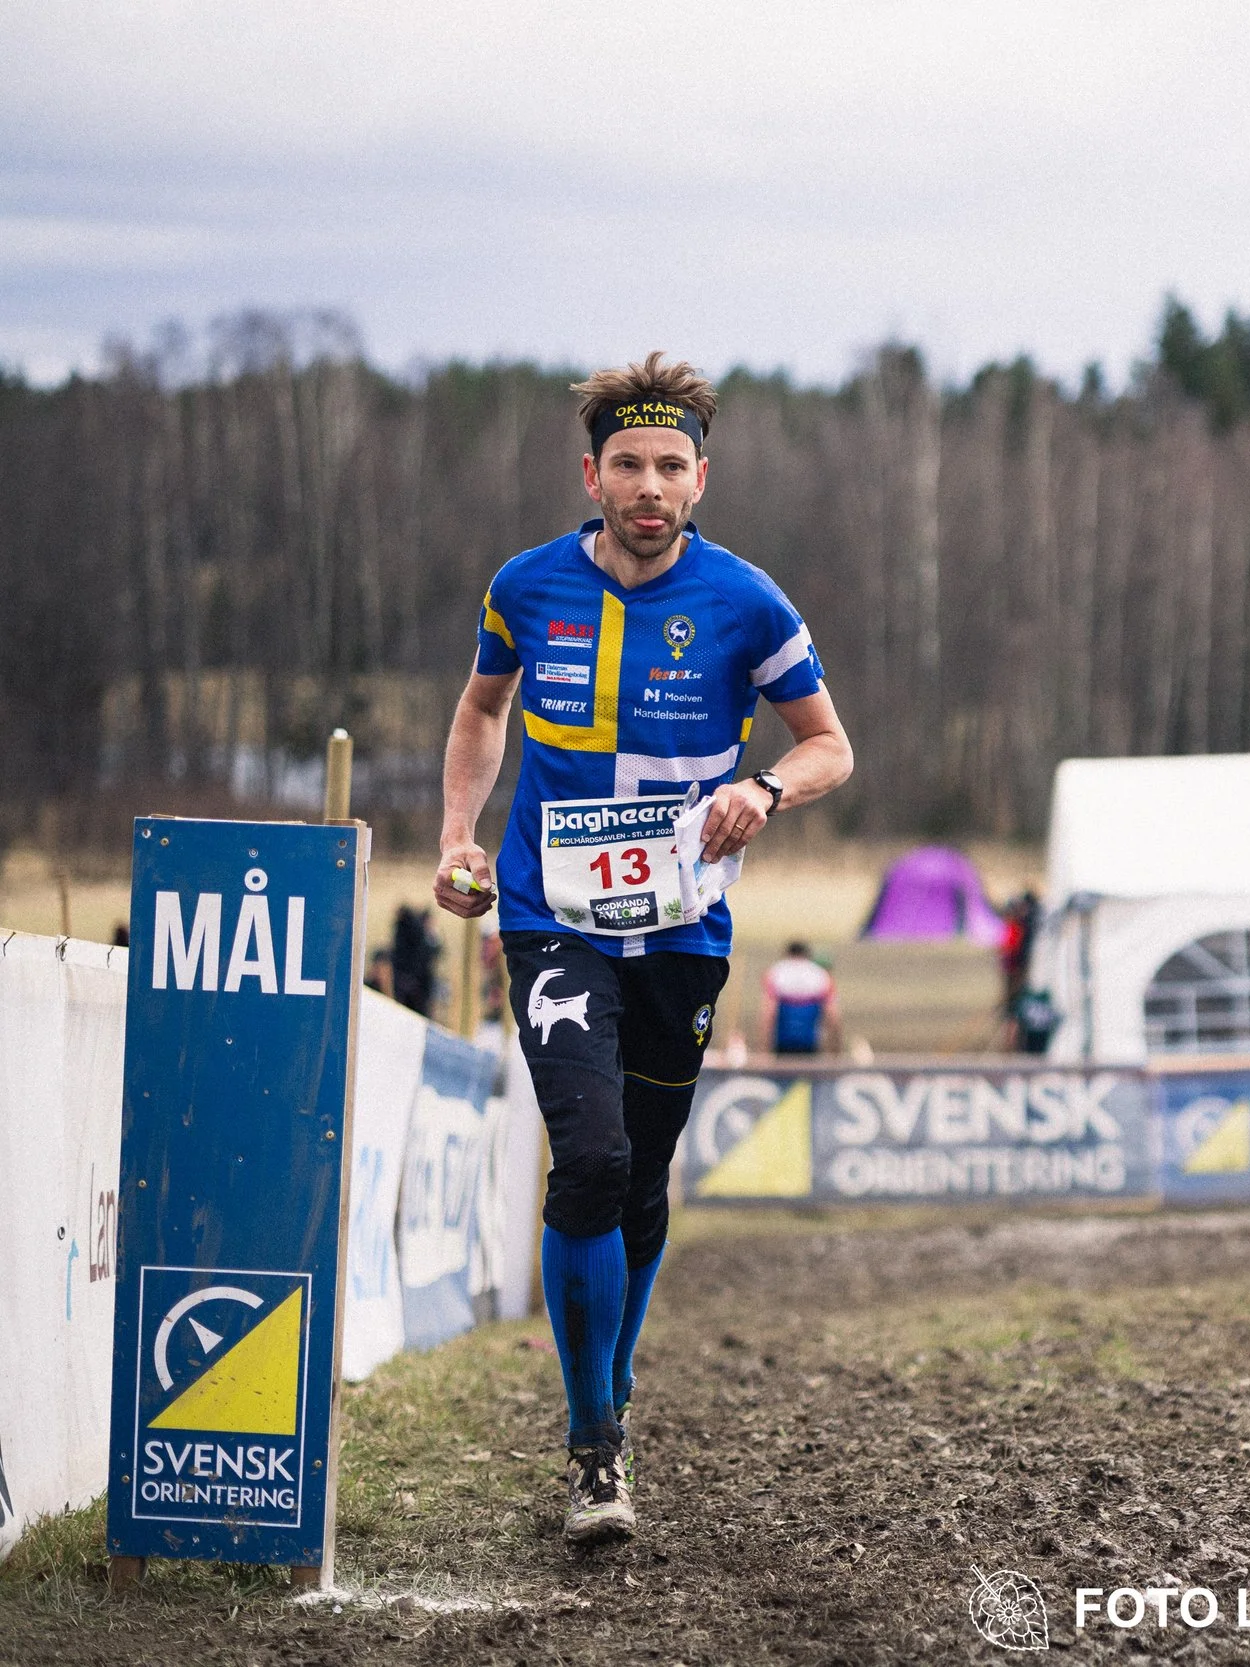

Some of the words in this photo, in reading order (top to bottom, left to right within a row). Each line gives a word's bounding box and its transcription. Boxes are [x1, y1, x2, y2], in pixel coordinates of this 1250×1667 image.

[616, 404, 638, 417] OK
[642, 401, 686, 419] KÅRE
[623, 415, 678, 427] FALUN
[541, 697, 588, 713] TRIMTEX
[664, 692, 703, 703] Moelven
[634, 707, 709, 721] Handelsbanken
[560, 833, 626, 845] KOLMÅRDSKAVLEN
[631, 830, 644, 839] STL
[645, 829, 655, 837] #1
[656, 827, 674, 836] 2026
[589, 847, 652, 890] 13
[595, 897, 651, 912] GODKÄNDA
[152, 868, 326, 996] MÅL
[832, 1071, 1124, 1145] SVENSK
[829, 1146, 1126, 1196] ORIENTERING
[143, 1440, 295, 1482] SVENSK
[140, 1481, 295, 1510] ORIENTERING
